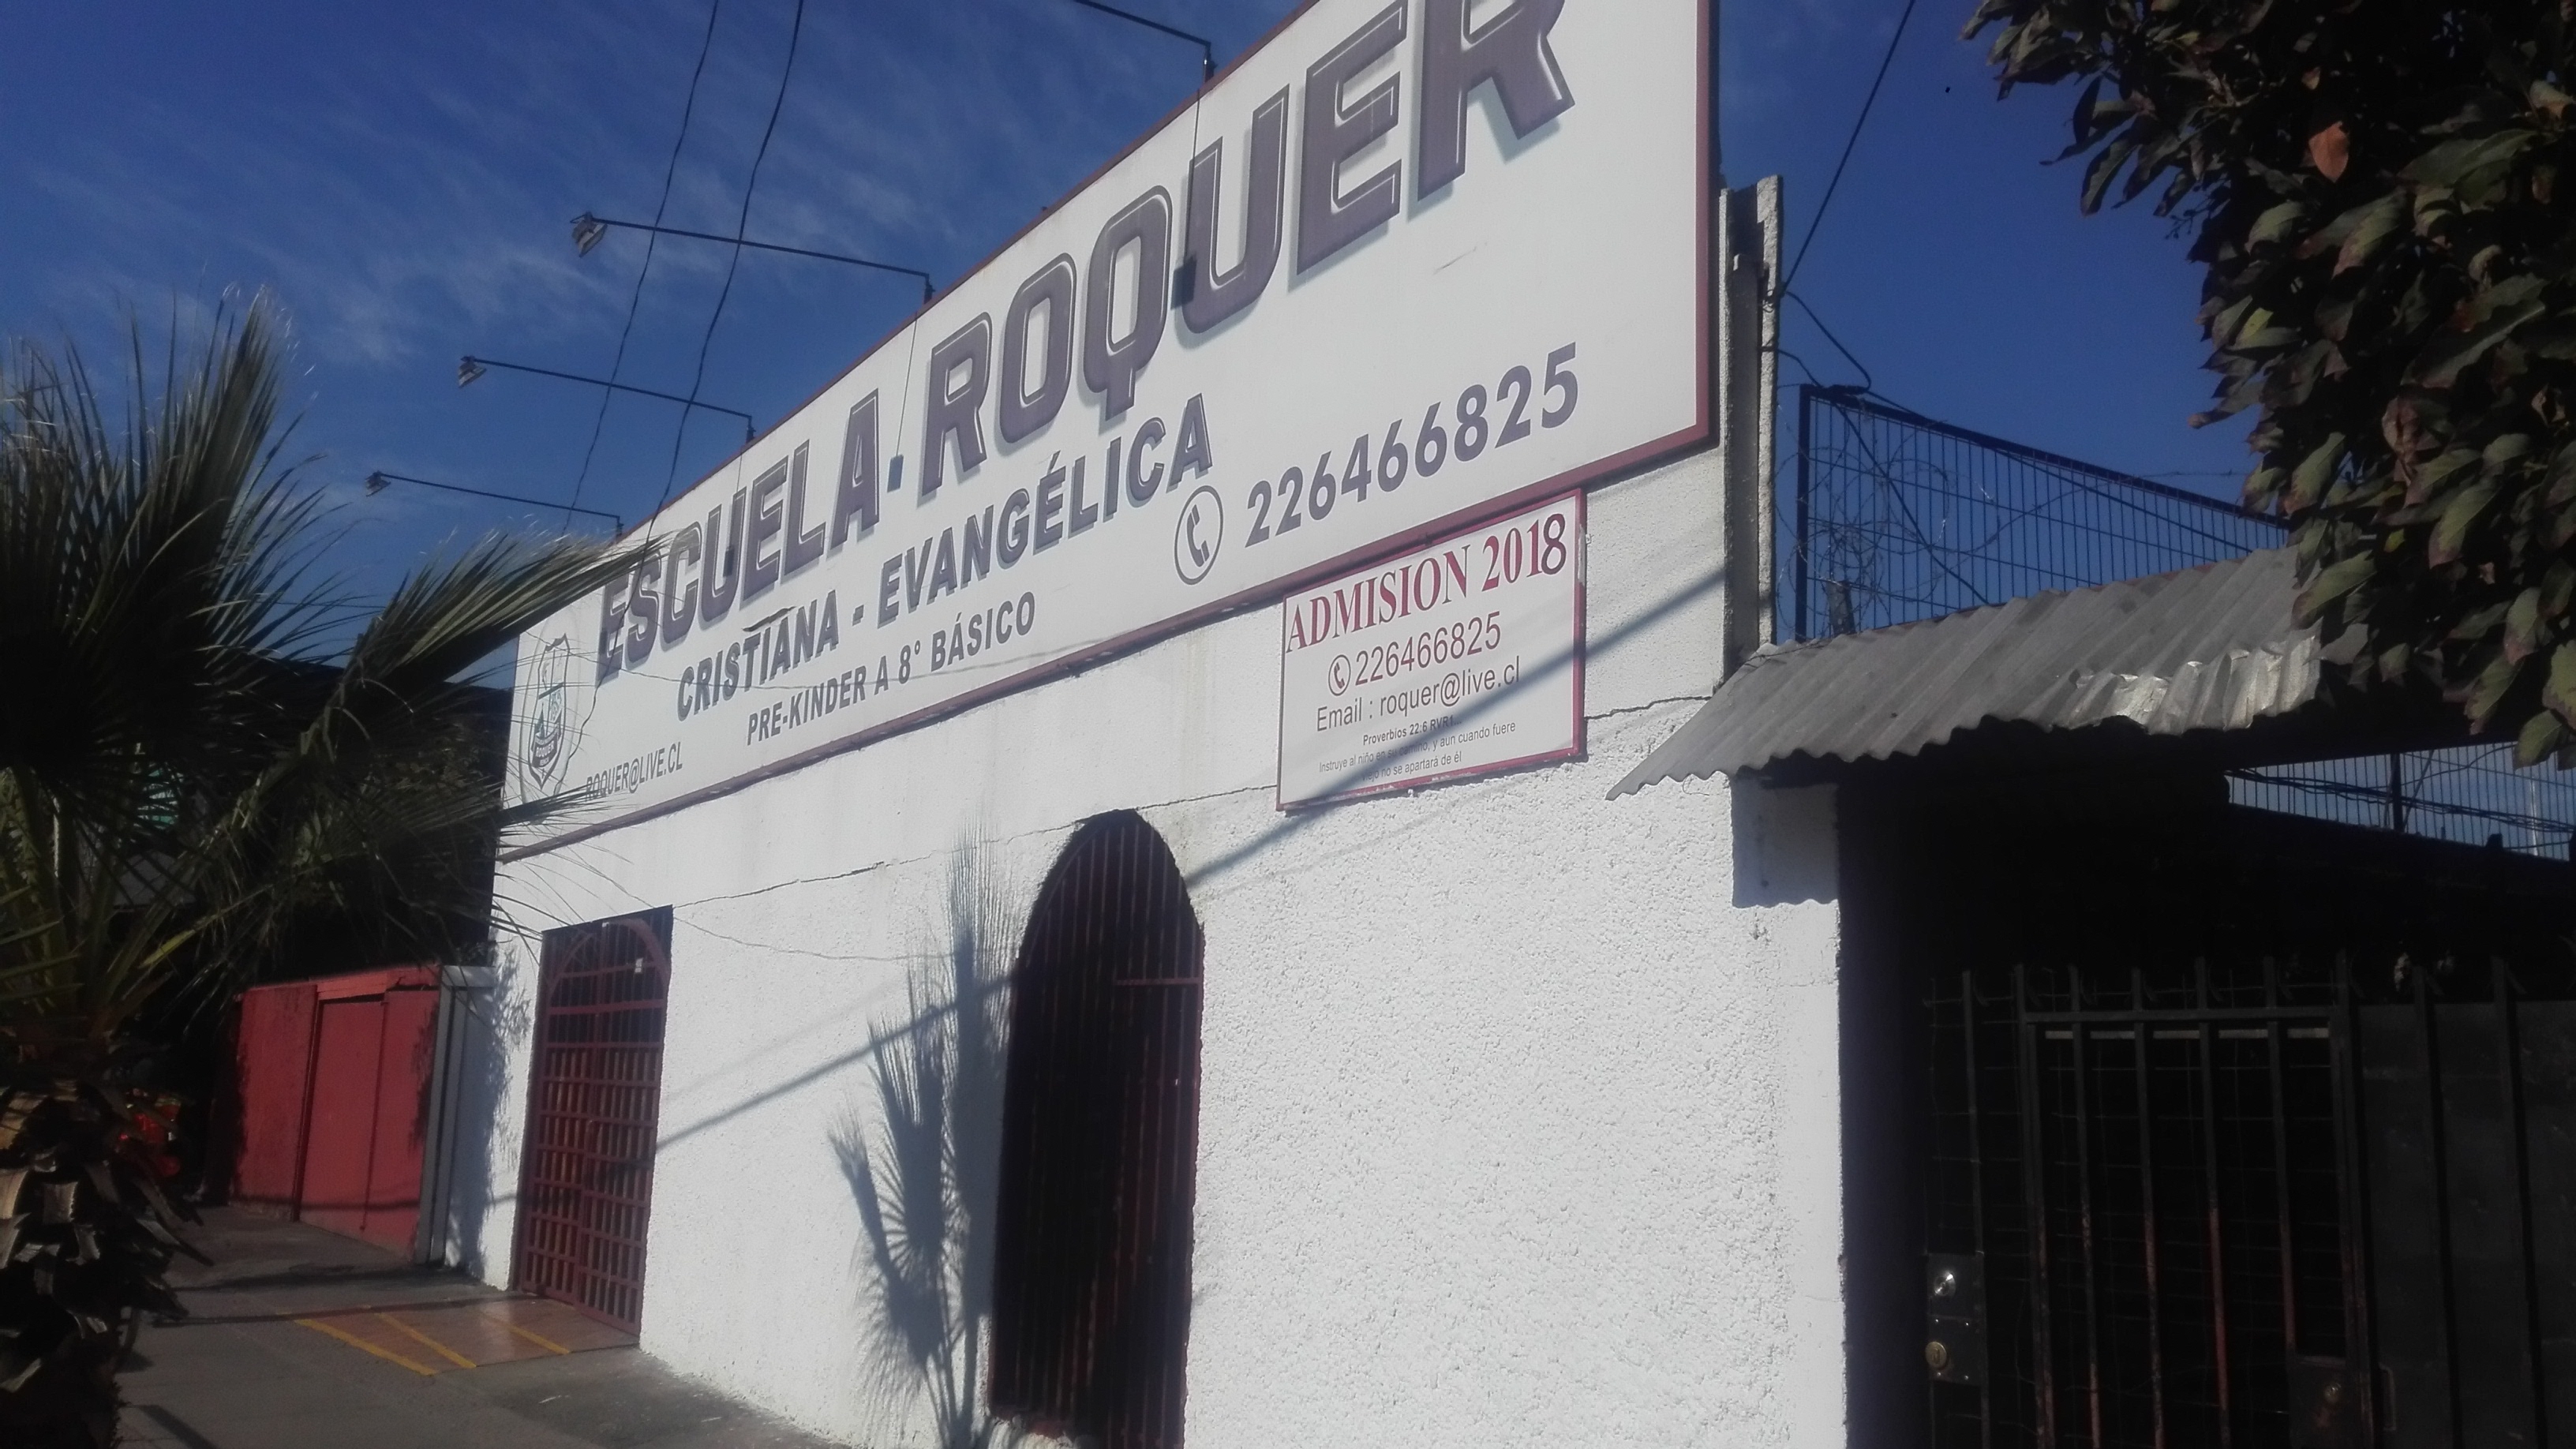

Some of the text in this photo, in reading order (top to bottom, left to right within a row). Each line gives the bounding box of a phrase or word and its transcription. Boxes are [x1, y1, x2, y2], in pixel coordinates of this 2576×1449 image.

[597, 0, 1574, 684] ESCUELA ROQUER
[1245, 342, 1578, 548] 226466825
[677, 590, 839, 720] CRISTIANA
[878, 393, 1213, 628] EVANGÉLICA
[1286, 513, 1567, 653] ADMISION 2018
[747, 665, 867, 746] PRE-KINDER
[874, 655, 891, 695] A
[930, 592, 1036, 672] BÁSICO
[1355, 611, 1501, 687] 226466825
[1317, 698, 1362, 732] Email
[1380, 656, 1519, 718] roquer@live.cl
[585, 741, 683, 802] ROQUER@LIVE.CL
[1319, 759, 1347, 773] Instruye
[1350, 754, 1356, 766] al
[1358, 751, 1374, 764] niño
[1376, 750, 1386, 761] en
[1388, 747, 1398, 758] su
[1432, 739, 1439, 752] y
[1440, 734, 1456, 747] aun
[1458, 725, 1490, 743] cuando
[1492, 721, 1516, 736] fuere
[1363, 728, 1406, 746] Proverbios
[1410, 721, 1427, 736] 22:6
[1381, 766, 1391, 777] no
[1393, 765, 1402, 775] se
[1405, 755, 1438, 776] apartará
[1441, 752, 1451, 766] de
[1454, 751, 1462, 763] él
